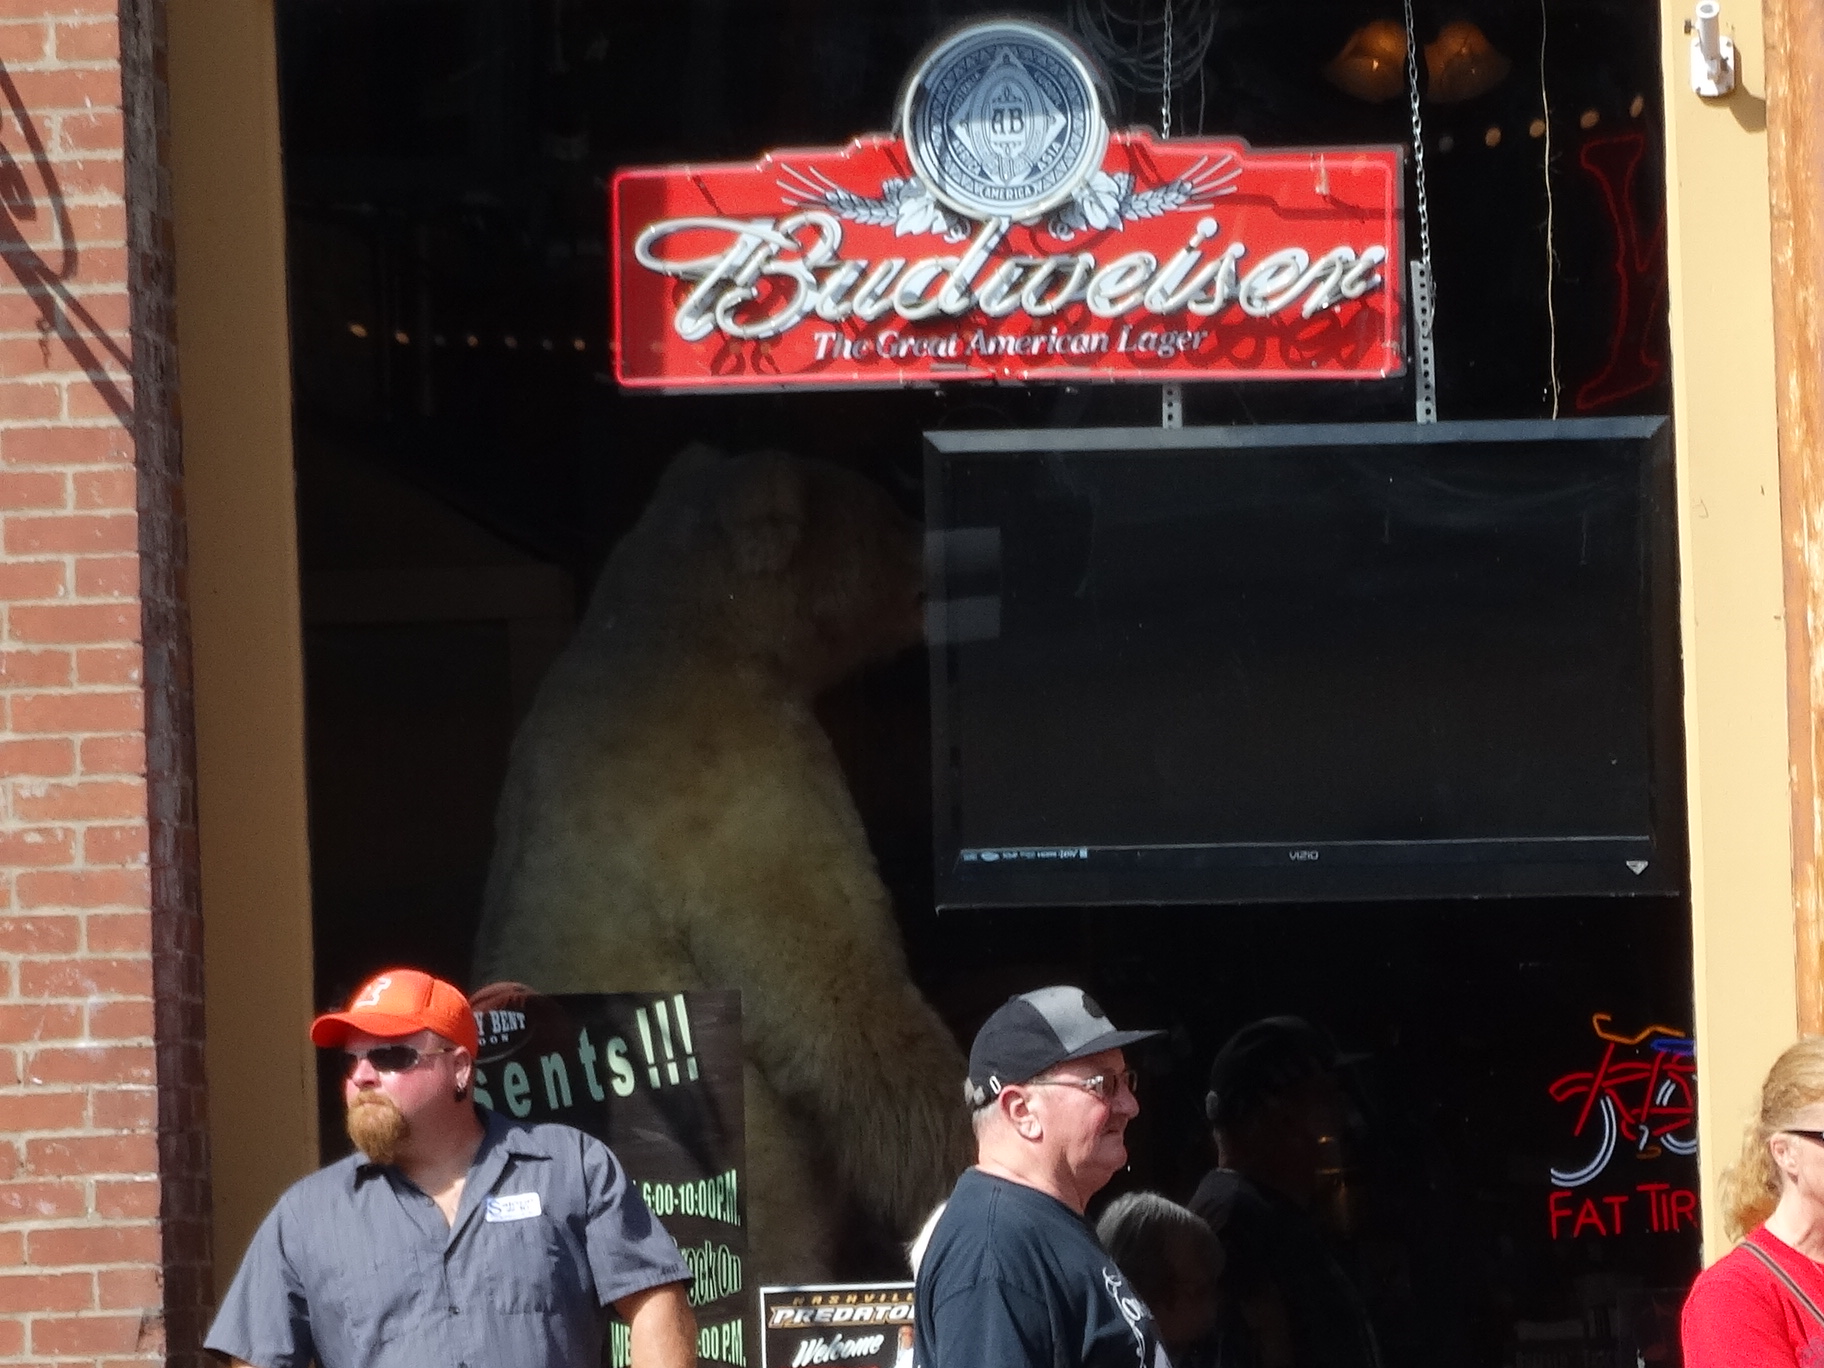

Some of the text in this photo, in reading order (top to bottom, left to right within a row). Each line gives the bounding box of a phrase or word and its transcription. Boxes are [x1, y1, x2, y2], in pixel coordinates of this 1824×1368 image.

[984, 186, 1034, 200] AMERICA
[634, 212, 1387, 341] Budweiser
[814, 325, 1208, 359] The Great American Lager
[491, 1010, 526, 1035] BENT
[474, 993, 699, 1118] sents!!!
[1549, 1184, 1698, 1240] FAT TIR
[718, 1244, 742, 1297] On
[773, 1305, 914, 1325] PREDATO
[793, 1292, 914, 1305] NASHVILL
[791, 1333, 884, 1368] Welcome
